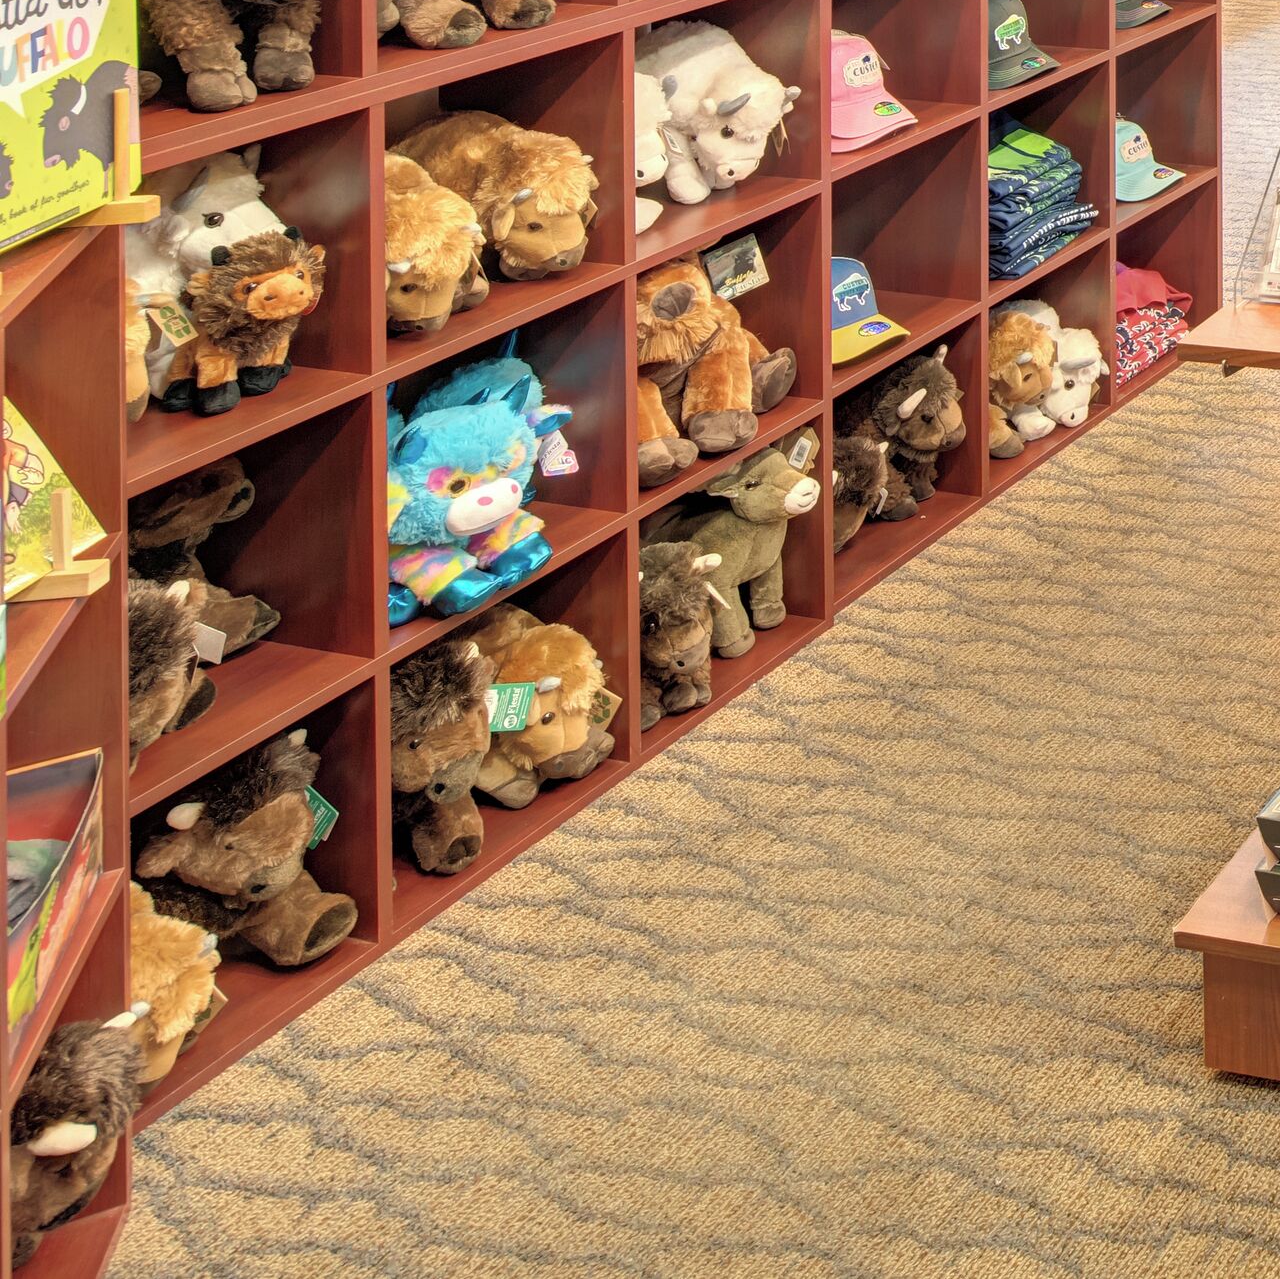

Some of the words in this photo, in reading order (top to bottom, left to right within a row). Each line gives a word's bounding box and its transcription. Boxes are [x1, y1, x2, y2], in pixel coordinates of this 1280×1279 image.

[0, 17, 90, 87] UFFALO
[1128, 141, 1148, 156] CUSTE
[507, 687, 521, 714] Fiesta
